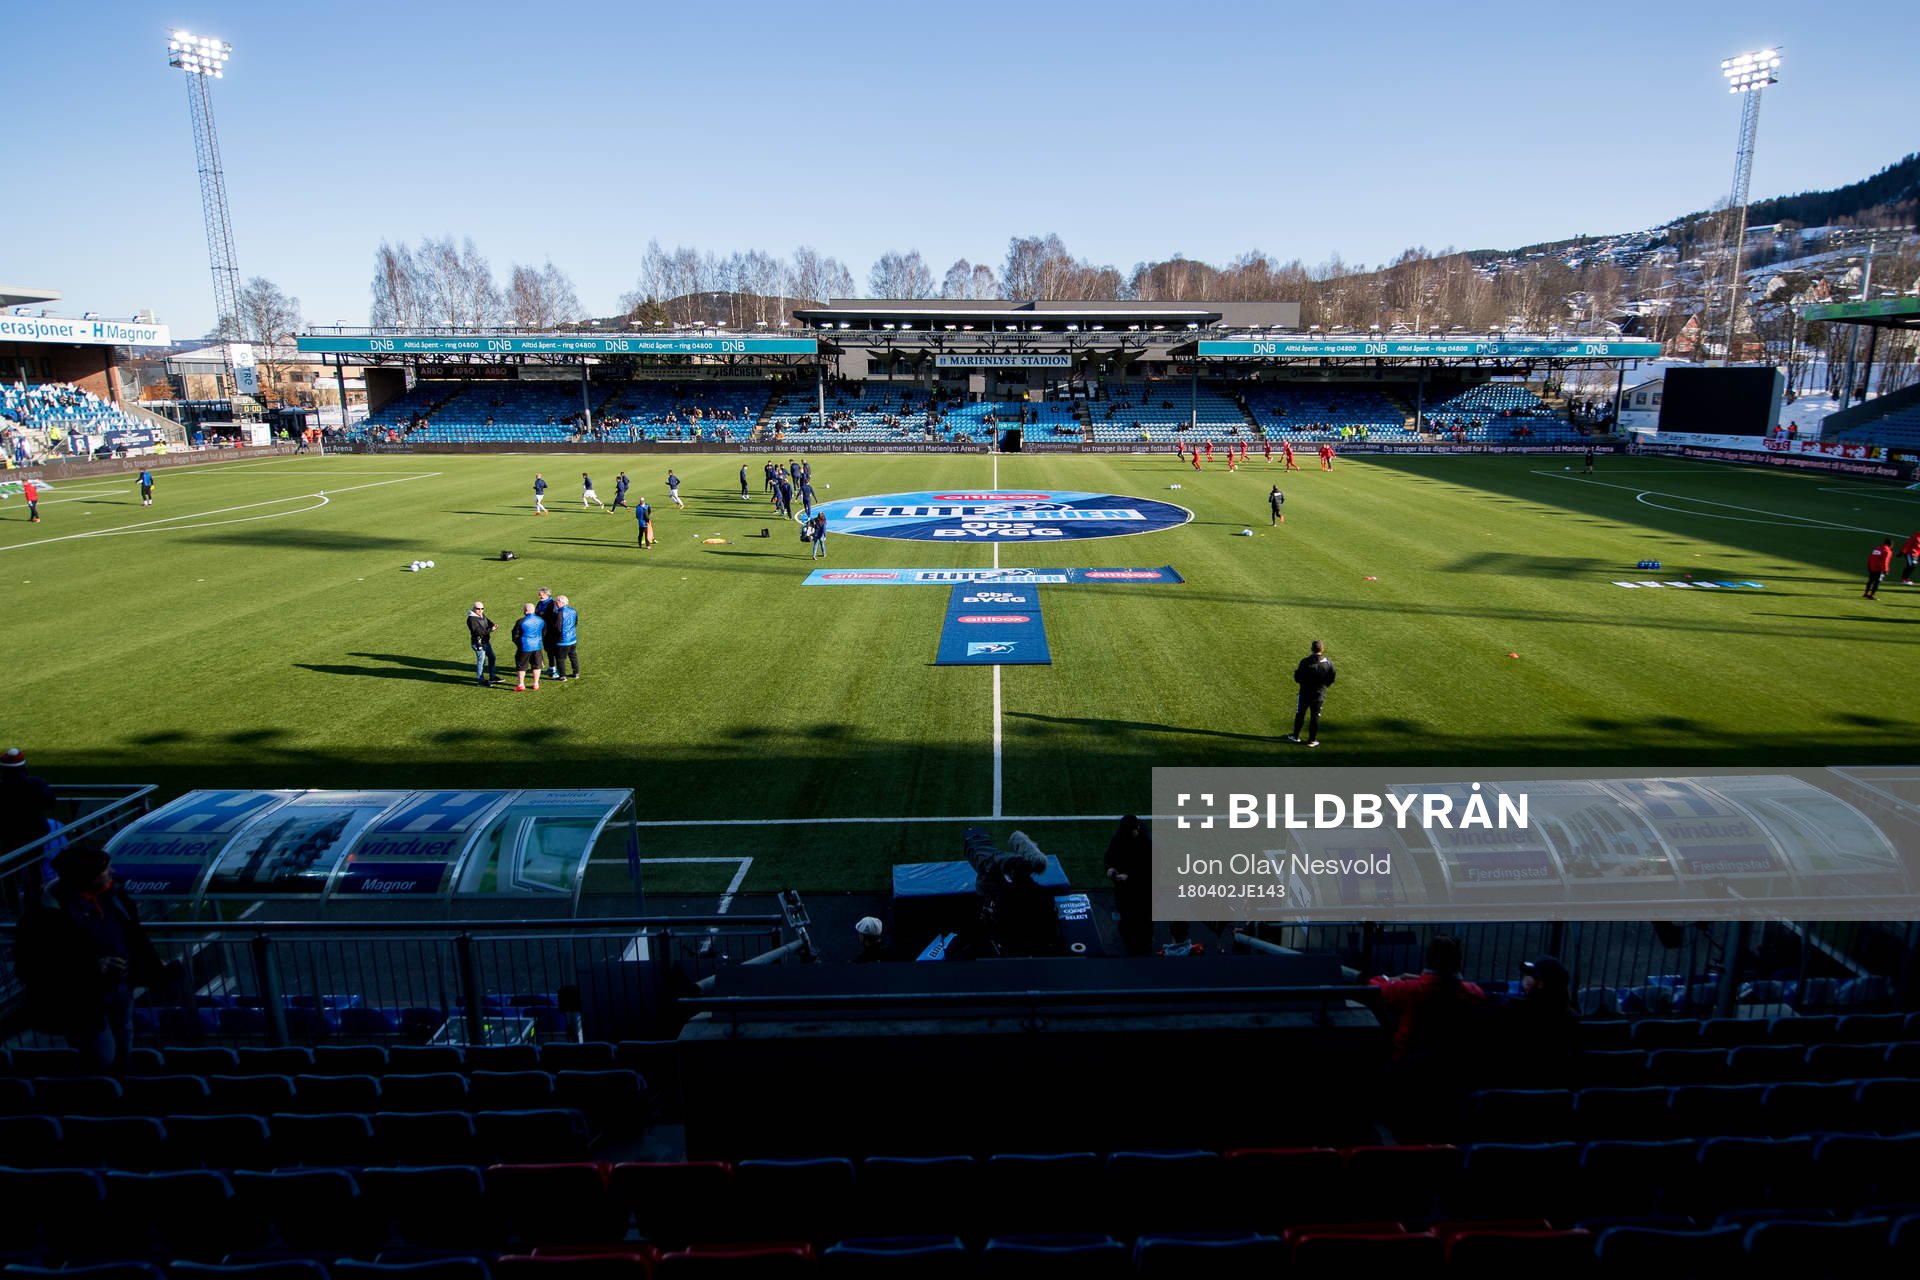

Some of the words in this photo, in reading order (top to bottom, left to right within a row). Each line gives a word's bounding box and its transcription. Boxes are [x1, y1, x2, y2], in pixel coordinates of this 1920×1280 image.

[0, 320, 73, 338] erasjoner
[107, 325, 158, 342] Magnor
[370, 338, 395, 352] DNB
[421, 341, 438, 350] åpent
[445, 341, 457, 350] ring
[488, 338, 512, 352] DNB
[522, 341, 537, 349] Alltid
[538, 341, 556, 350] åpent
[563, 342, 574, 350] ring
[605, 338, 629, 353] DNB
[639, 341, 655, 349] Alltid
[656, 341, 673, 351] åpent
[680, 342, 691, 351] ring
[722, 338, 746, 353] DNB
[1253, 342, 1276, 356] DNB
[1301, 344, 1318, 353] åpent
[1324, 345, 1335, 353] ring
[1365, 342, 1388, 356] DNB
[1413, 344, 1430, 353] åpent
[1435, 345, 1446, 353] ring
[1476, 342, 1498, 356] DNB
[1585, 343, 1608, 357] DNB
[950, 356, 1017, 365] MARIENLYST
[1022, 356, 1068, 365] STADION
[421, 367, 443, 375] ARBO
[484, 367, 507, 375] ARBO
[333, 444, 353, 452] Arena
[749, 445, 773, 453] trenger
[790, 445, 808, 453] digge
[848, 445, 866, 453] legge
[926, 445, 959, 453] Marienlyst
[1131, 445, 1149, 453] digge
[1877, 465, 1898, 475] Arena
[859, 506, 989, 516] ELITE
[933, 528, 1064, 537] BYGG
[921, 572, 987, 580] ELITE
[1665, 820, 1754, 839] vinduet
[117, 836, 215, 857] vinduet
[357, 837, 457, 857] vinduet
[1692, 859, 1770, 874] Fjerdingstad
[1468, 866, 1548, 882] Fjerdingstad
[361, 877, 416, 891] Magnor
